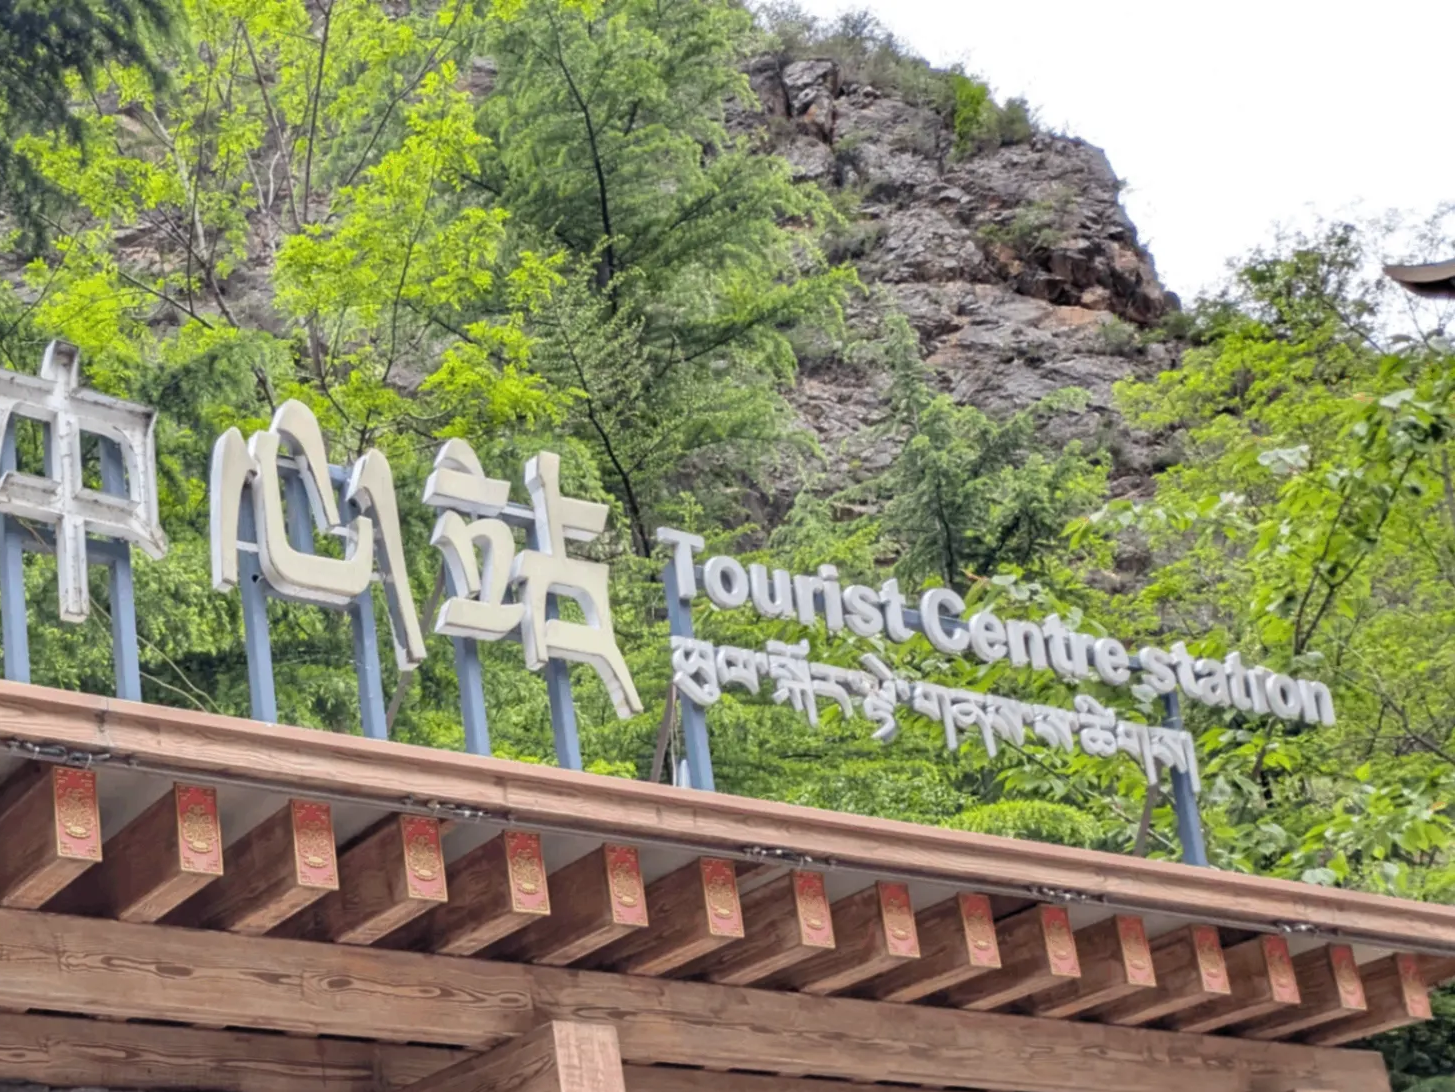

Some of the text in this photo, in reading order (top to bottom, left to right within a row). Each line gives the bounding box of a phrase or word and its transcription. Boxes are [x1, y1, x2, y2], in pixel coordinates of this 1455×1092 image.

[657, 527, 1336, 726] Tourist Centre station
